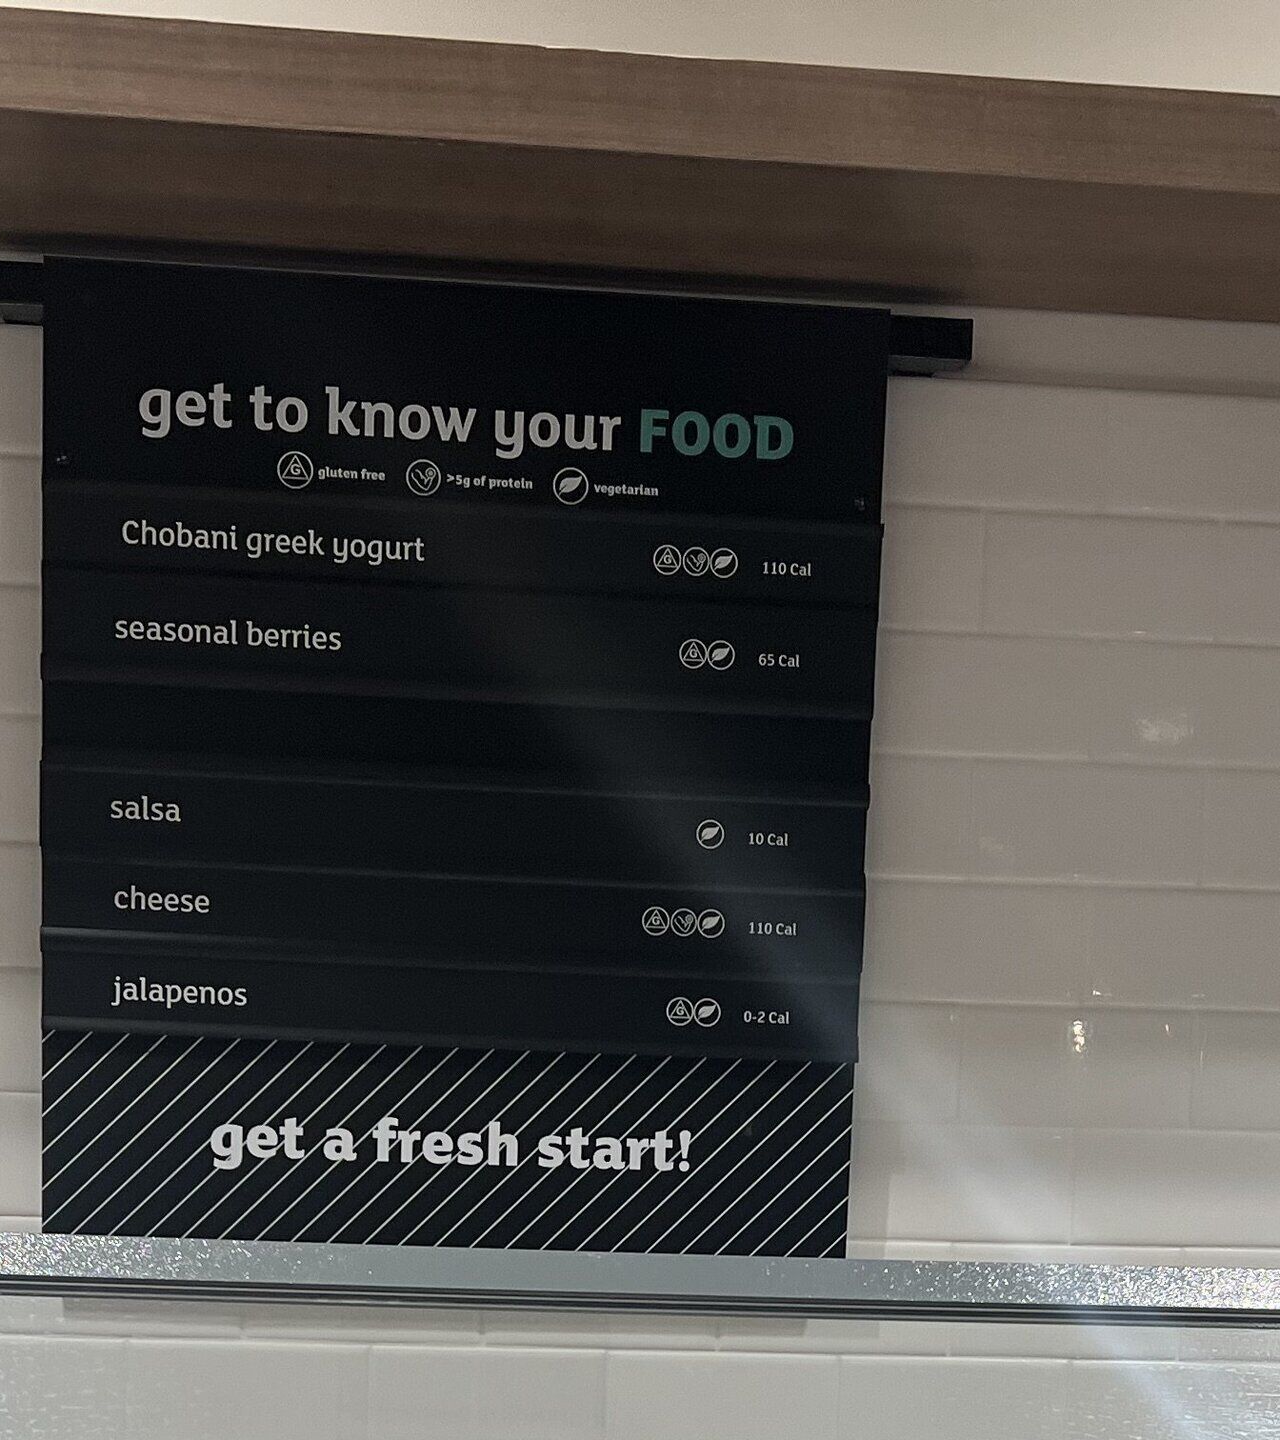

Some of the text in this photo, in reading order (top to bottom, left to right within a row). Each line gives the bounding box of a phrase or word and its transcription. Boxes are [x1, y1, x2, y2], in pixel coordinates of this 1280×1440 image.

[139, 383, 793, 459] get to know your FOOD
[318, 466, 385, 480] gluten free
[447, 474, 470, 488] >5g
[489, 478, 532, 489] protein
[594, 484, 658, 496] vegetarian
[122, 520, 424, 565] Chobani greek yogurt
[763, 562, 811, 576] 110 Cal
[116, 620, 341, 650] seasonal berries
[759, 654, 799, 667] 65 Cal
[111, 796, 181, 822] salsa
[749, 833, 788, 846] 10 Cal
[115, 885, 209, 913] cheese
[750, 922, 796, 935] 110 Cal
[111, 976, 246, 1008] jalapenos
[744, 1011, 789, 1024] 0-2 Cal
[210, 1116, 693, 1173] get a fresh start!
